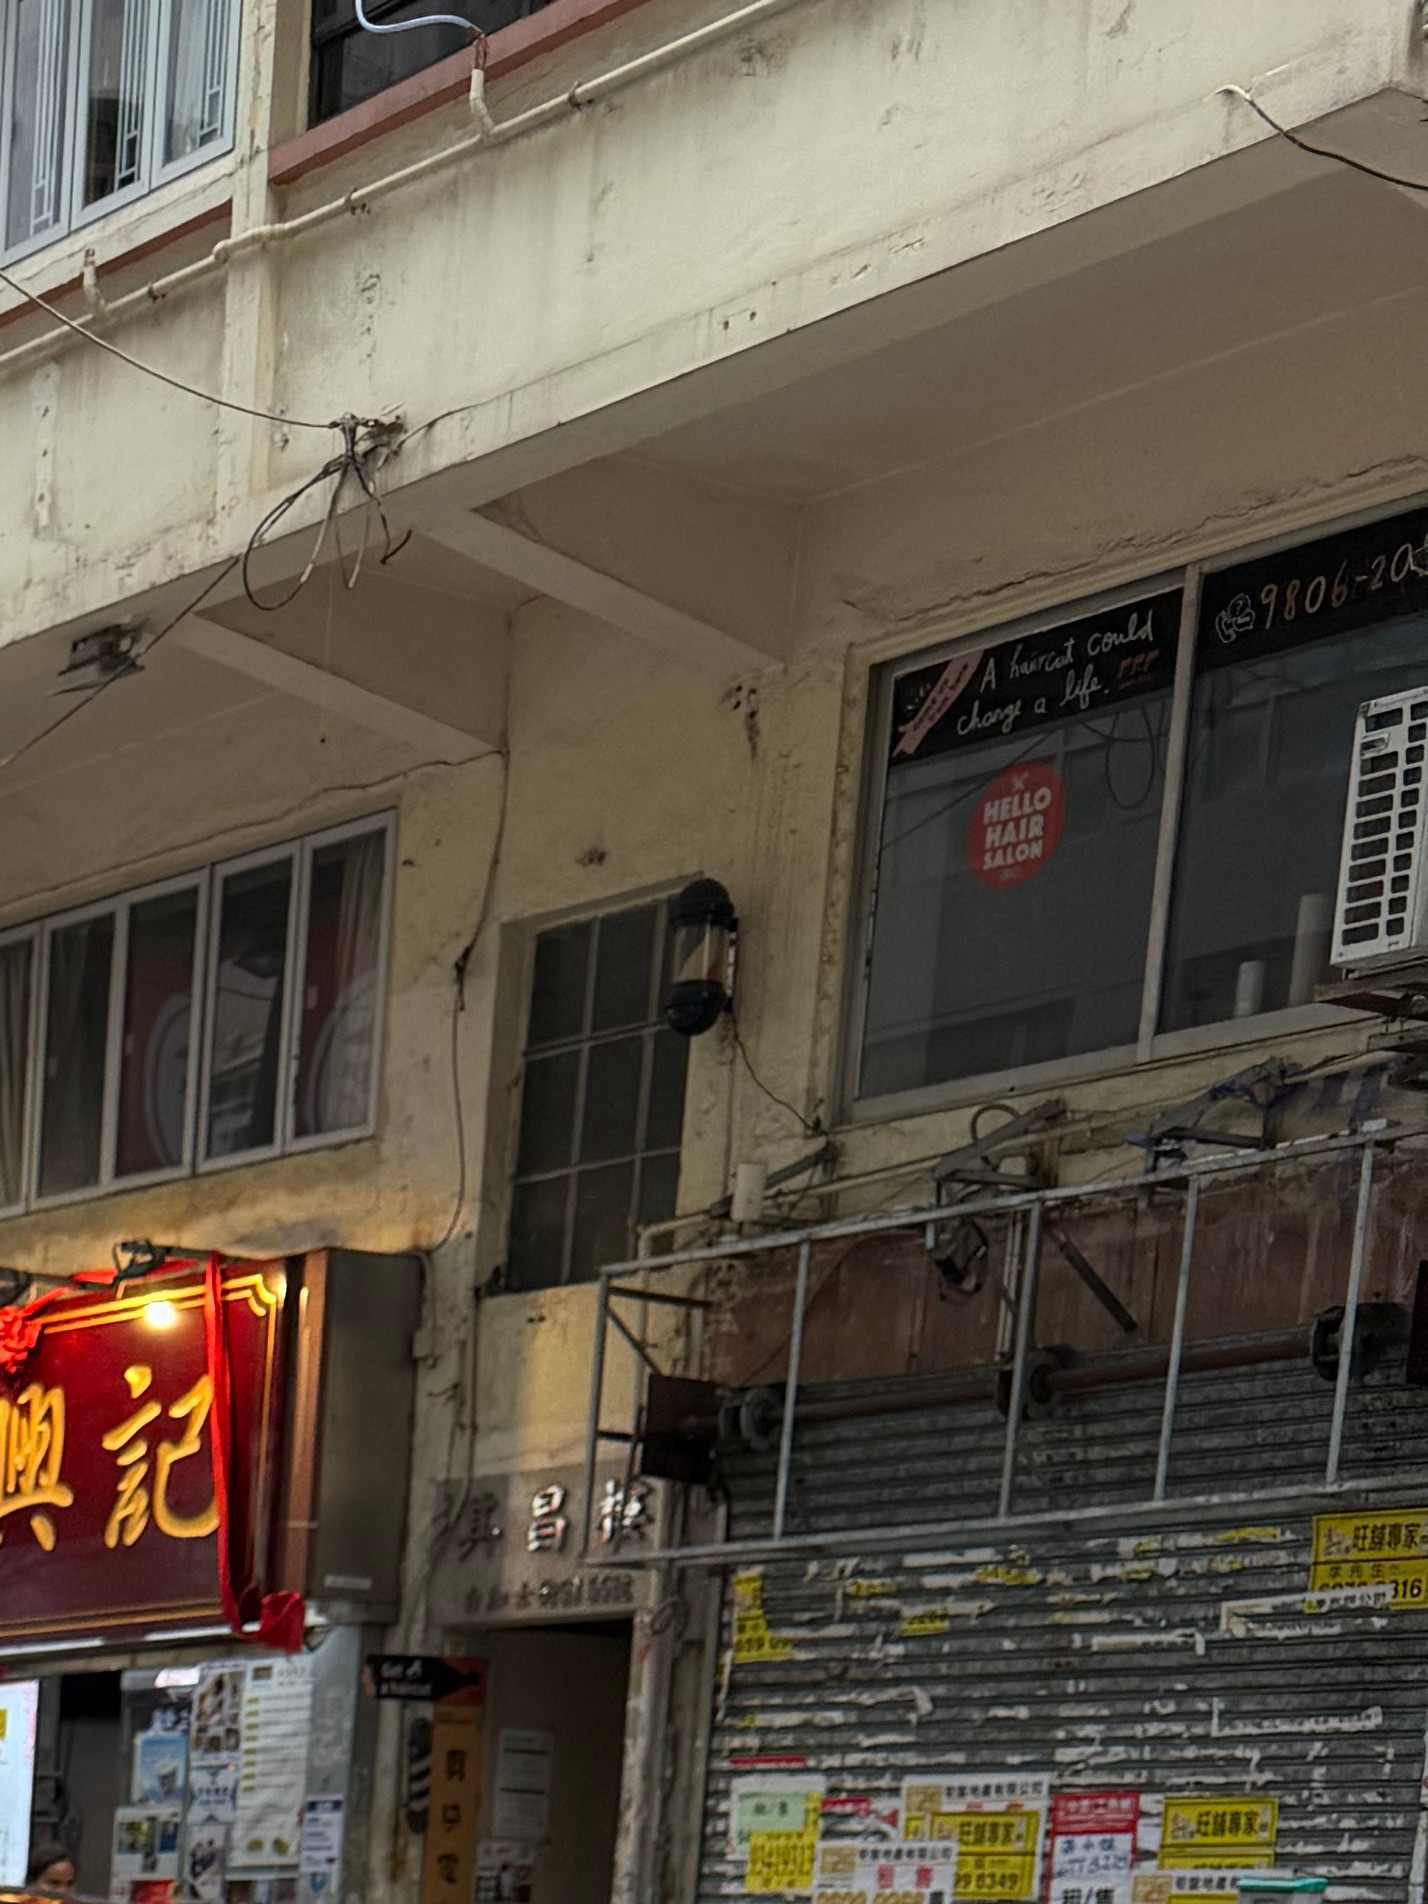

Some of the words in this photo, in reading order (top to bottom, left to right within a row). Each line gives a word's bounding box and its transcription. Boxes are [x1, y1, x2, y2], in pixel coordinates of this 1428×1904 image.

[979, 657, 996, 693] A
[1009, 637, 1075, 680] haircut
[1087, 608, 1154, 656] could
[956, 698, 1022, 736] change
[1059, 663, 1111, 709] life.
[983, 786, 1052, 825] HELLO
[985, 814, 1044, 850] HAIR
[983, 839, 1044, 870] SALON
[1375, 1578, 1423, 1599] 316
